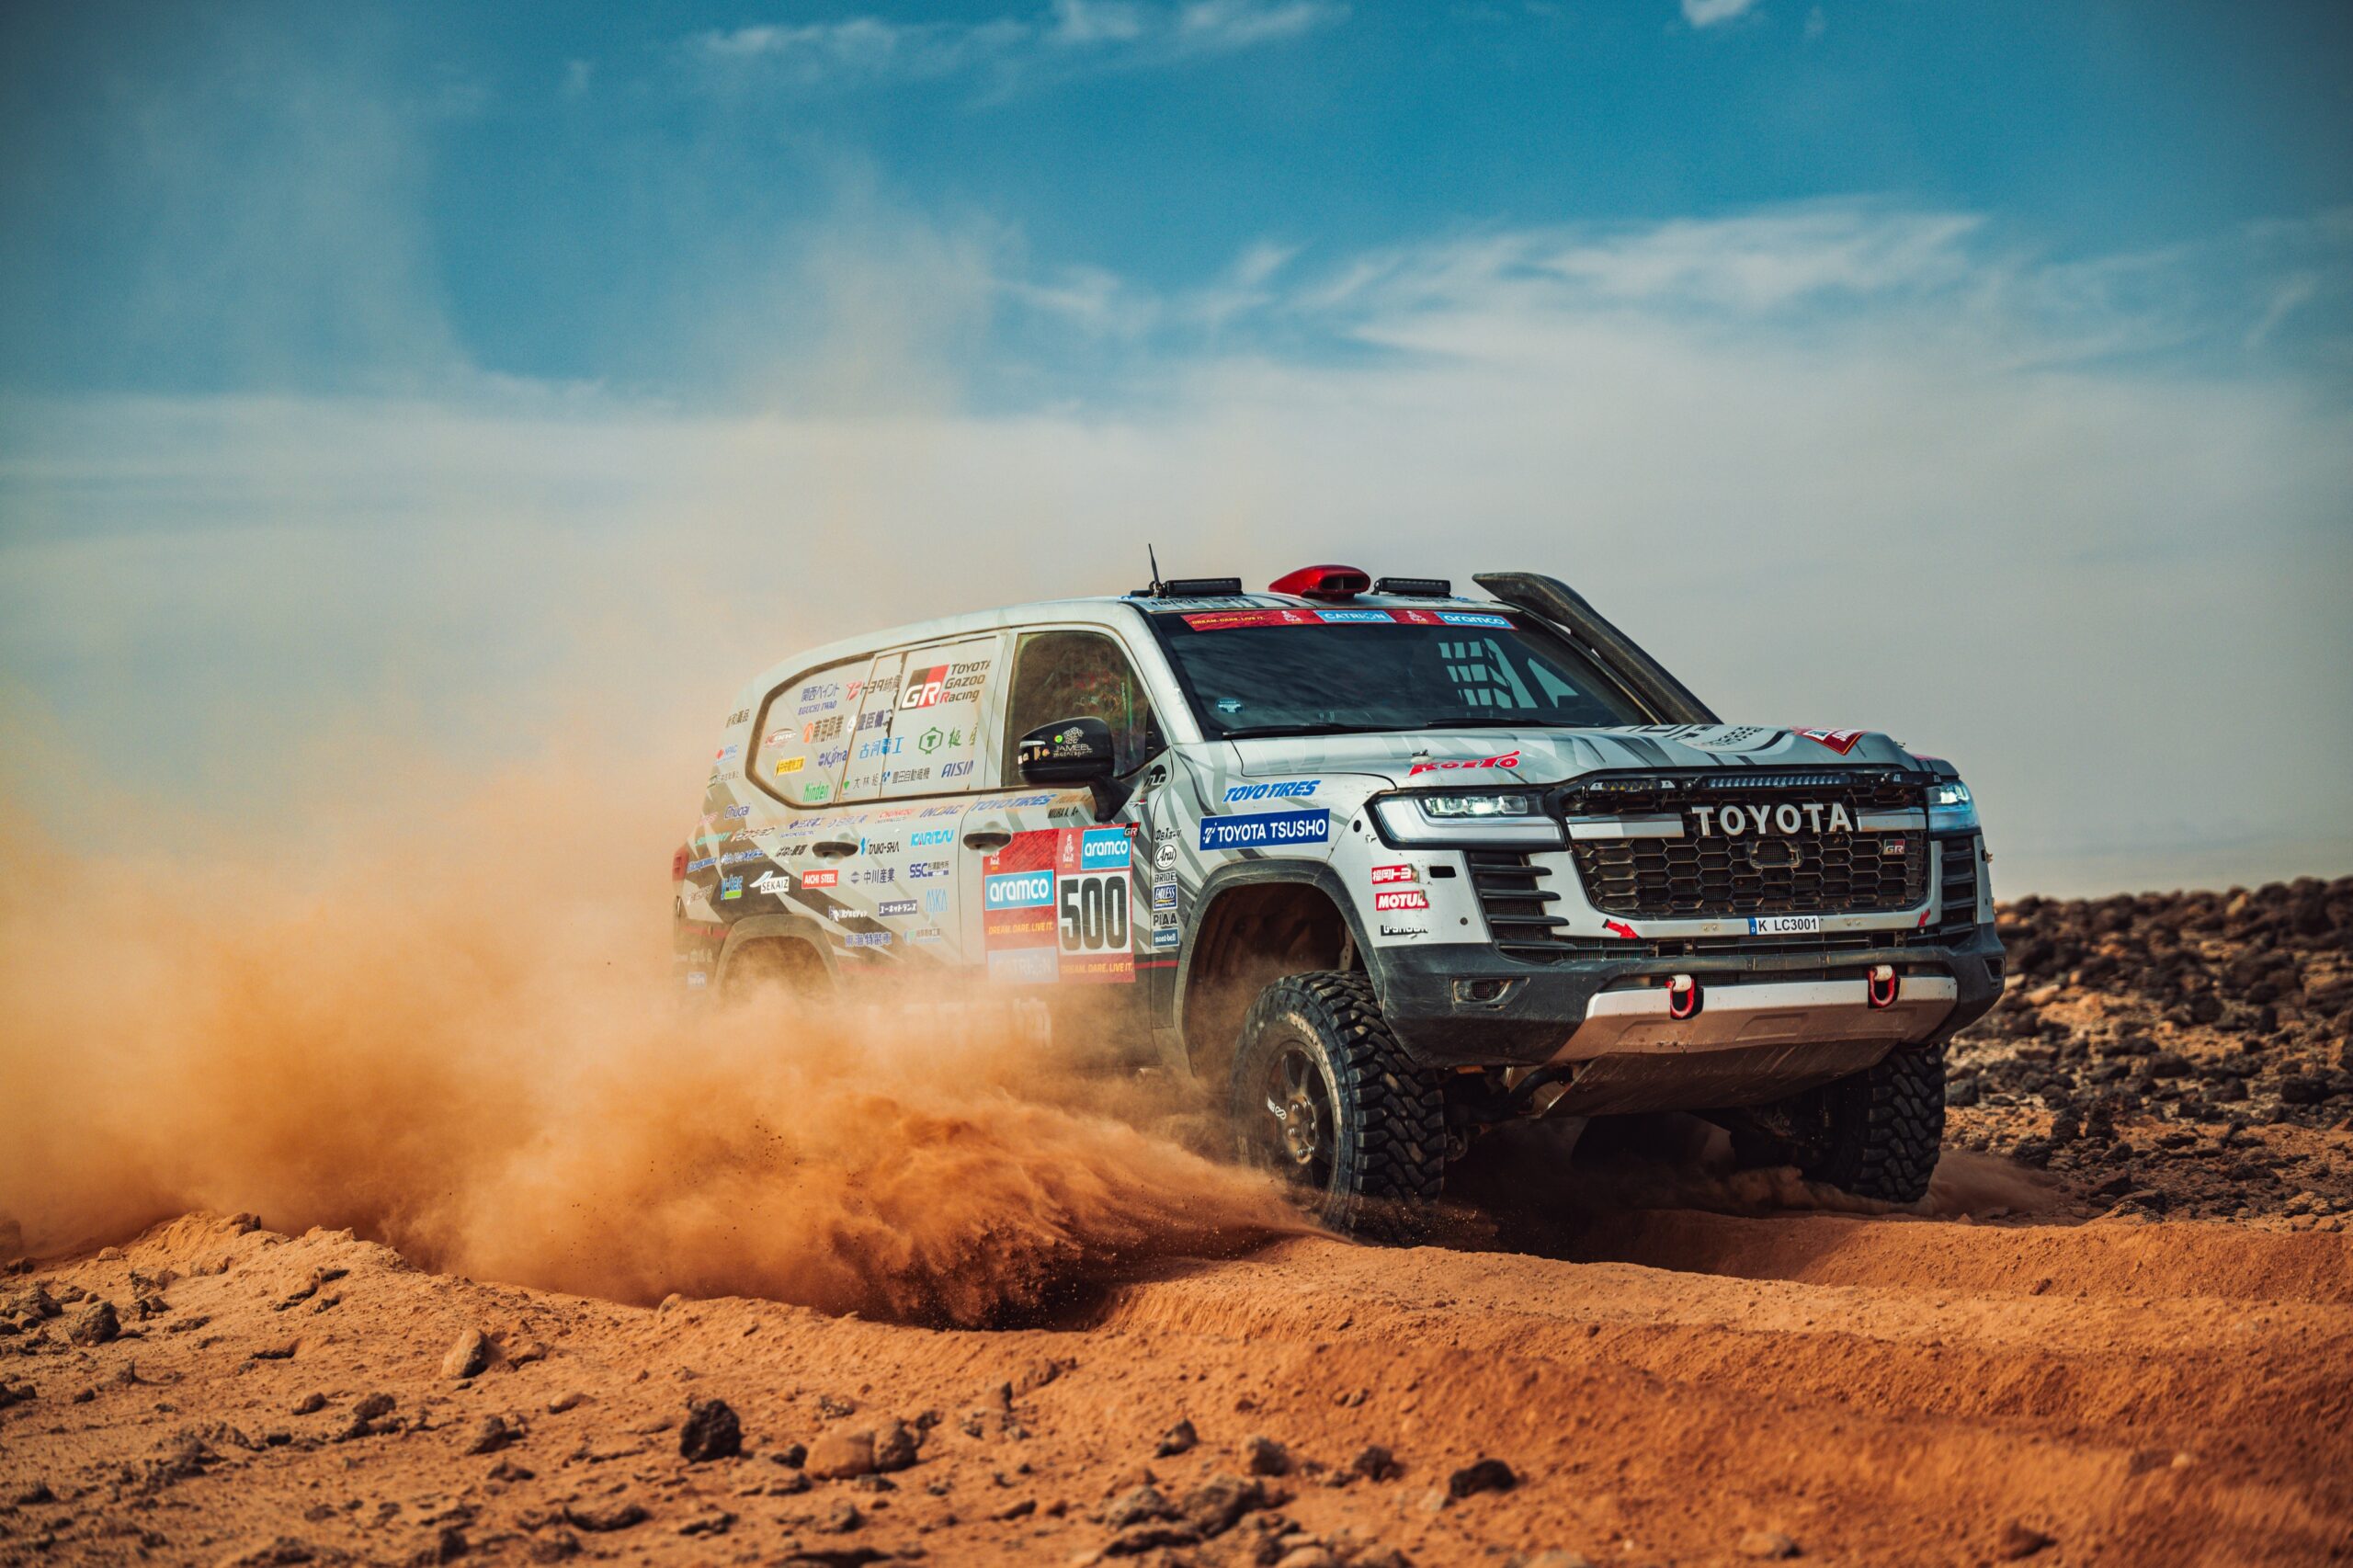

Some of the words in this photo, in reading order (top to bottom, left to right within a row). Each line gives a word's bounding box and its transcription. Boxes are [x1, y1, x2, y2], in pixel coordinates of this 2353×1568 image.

[1444, 614, 1505, 626] aramco
[945, 674, 985, 689] GAZOO
[901, 681, 941, 709] GR
[939, 689, 981, 704] Racing
[1055, 744, 1093, 752] JAMEEL
[1222, 784, 1269, 803] TOYO
[1267, 779, 1322, 799] TIRES
[1691, 801, 1853, 836] TOYOTA
[1123, 827, 1139, 836] GR
[1217, 823, 1267, 843] TOYOTA
[1269, 819, 1326, 840] TSUSHO
[1084, 840, 1129, 858] aramco
[1156, 847, 1175, 862] Arai
[1885, 844, 1904, 854] GR
[863, 868, 895, 885] 中川産業
[909, 862, 928, 879] SSC
[1154, 871, 1176, 883] BRIDE
[804, 874, 820, 884] AICHI
[821, 873, 835, 883] STEEL
[989, 878, 1050, 903] aramco
[1155, 886, 1176, 900] ENDLESS
[926, 888, 948, 913] ASKA
[1378, 893, 1426, 908] MOTUL
[1061, 876, 1128, 951] 500
[1154, 913, 1177, 926] PIAA
[988, 925, 1012, 935] DREAM.
[1013, 924, 1031, 933] DARE.
[1031, 923, 1045, 932] LIVE
[1045, 922, 1054, 931] IT.
[1758, 920, 1767, 932] K
[1774, 918, 1817, 932] LC3001
[1087, 962, 1108, 974] DARE.
[1108, 962, 1124, 972] LIVE
[1124, 961, 1134, 971] IT.
